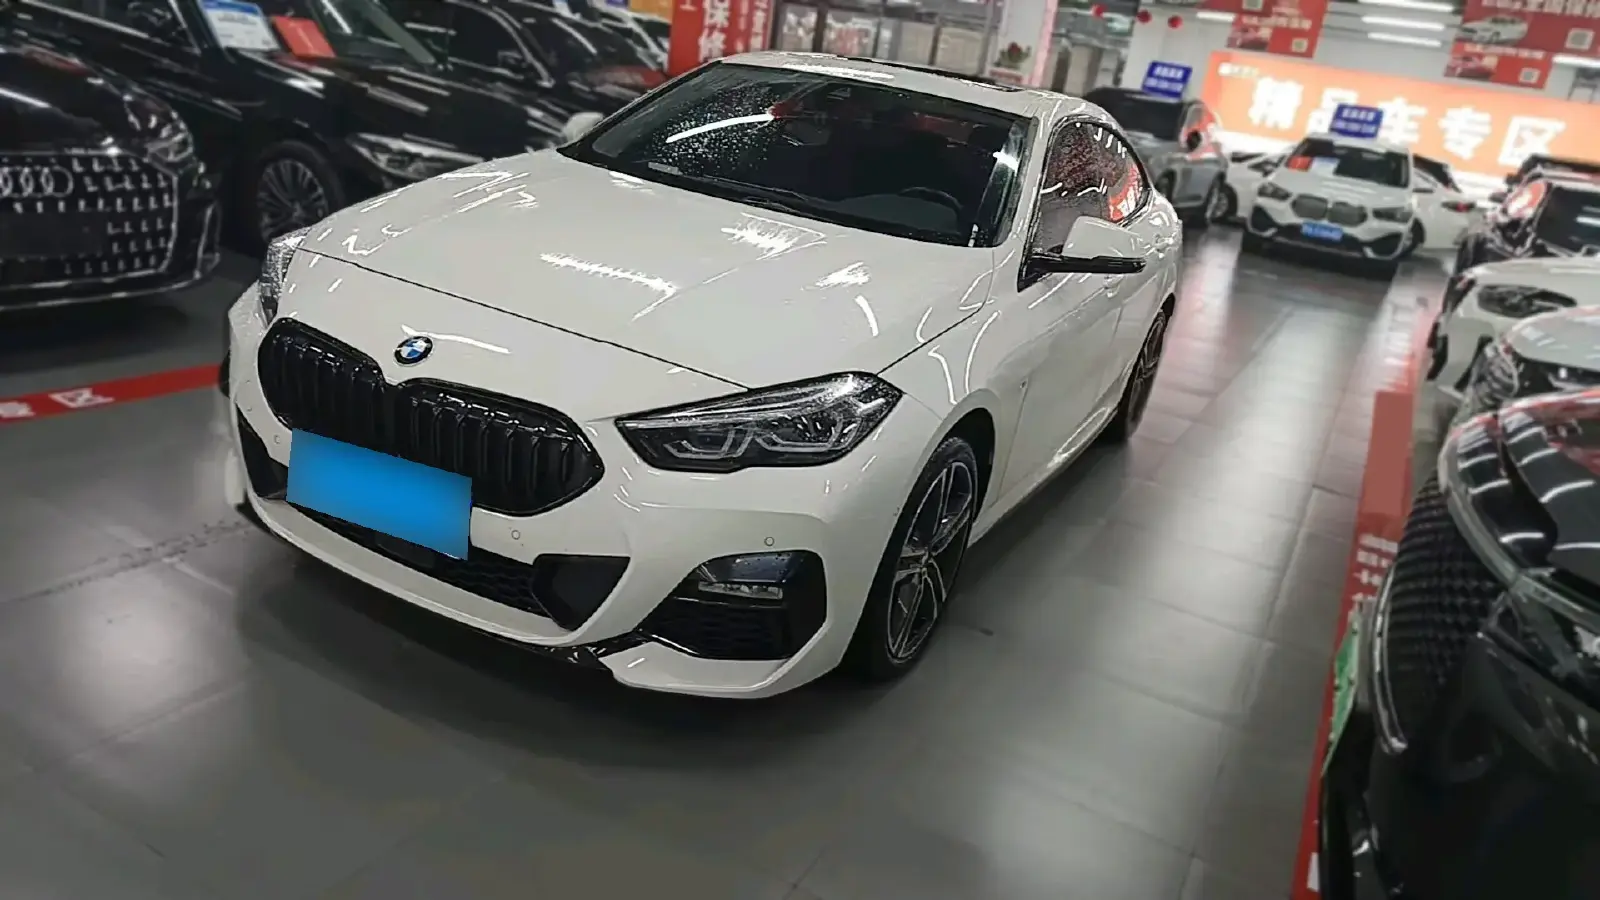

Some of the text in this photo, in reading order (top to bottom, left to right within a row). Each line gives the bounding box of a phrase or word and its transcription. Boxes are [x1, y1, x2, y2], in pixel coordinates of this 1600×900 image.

[1248, 76, 1567, 166] 精品车专区
